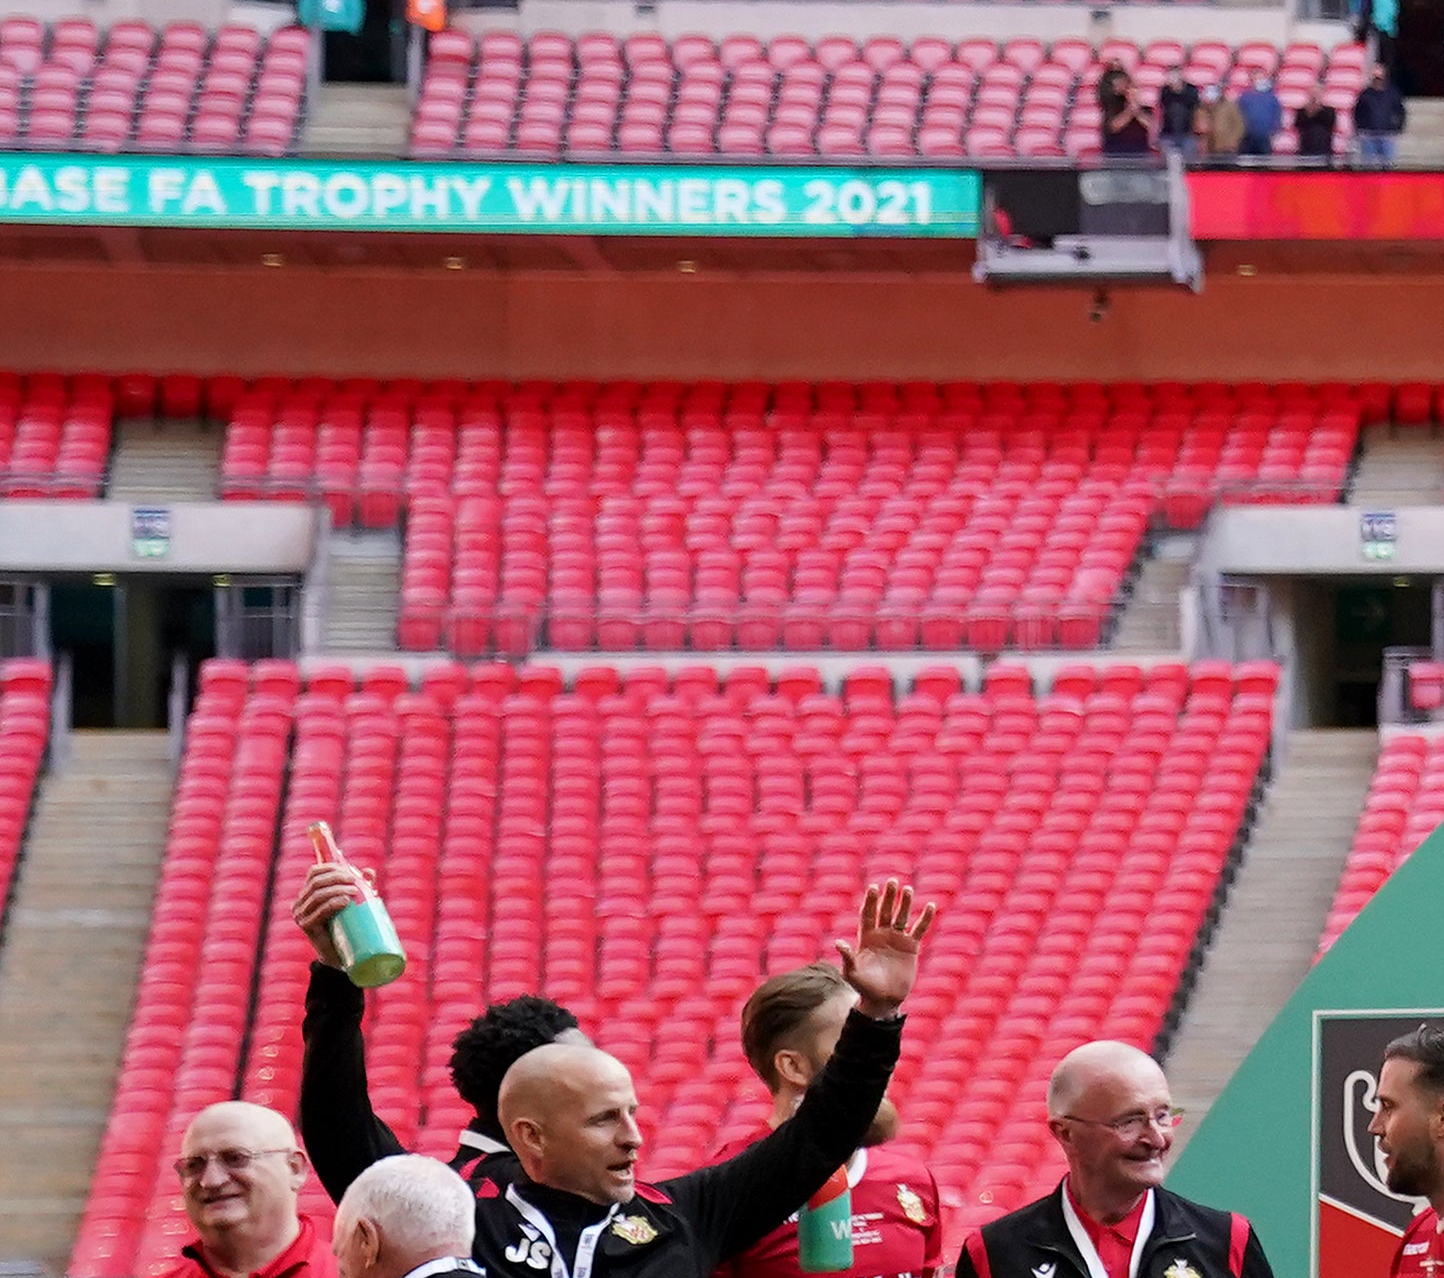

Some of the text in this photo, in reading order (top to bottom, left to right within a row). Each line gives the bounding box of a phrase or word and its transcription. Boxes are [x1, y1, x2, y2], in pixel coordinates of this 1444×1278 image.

[0, 166, 933, 227] ASE FA TROPHY WINNERS 2021
[504, 1237, 551, 1270] JS
